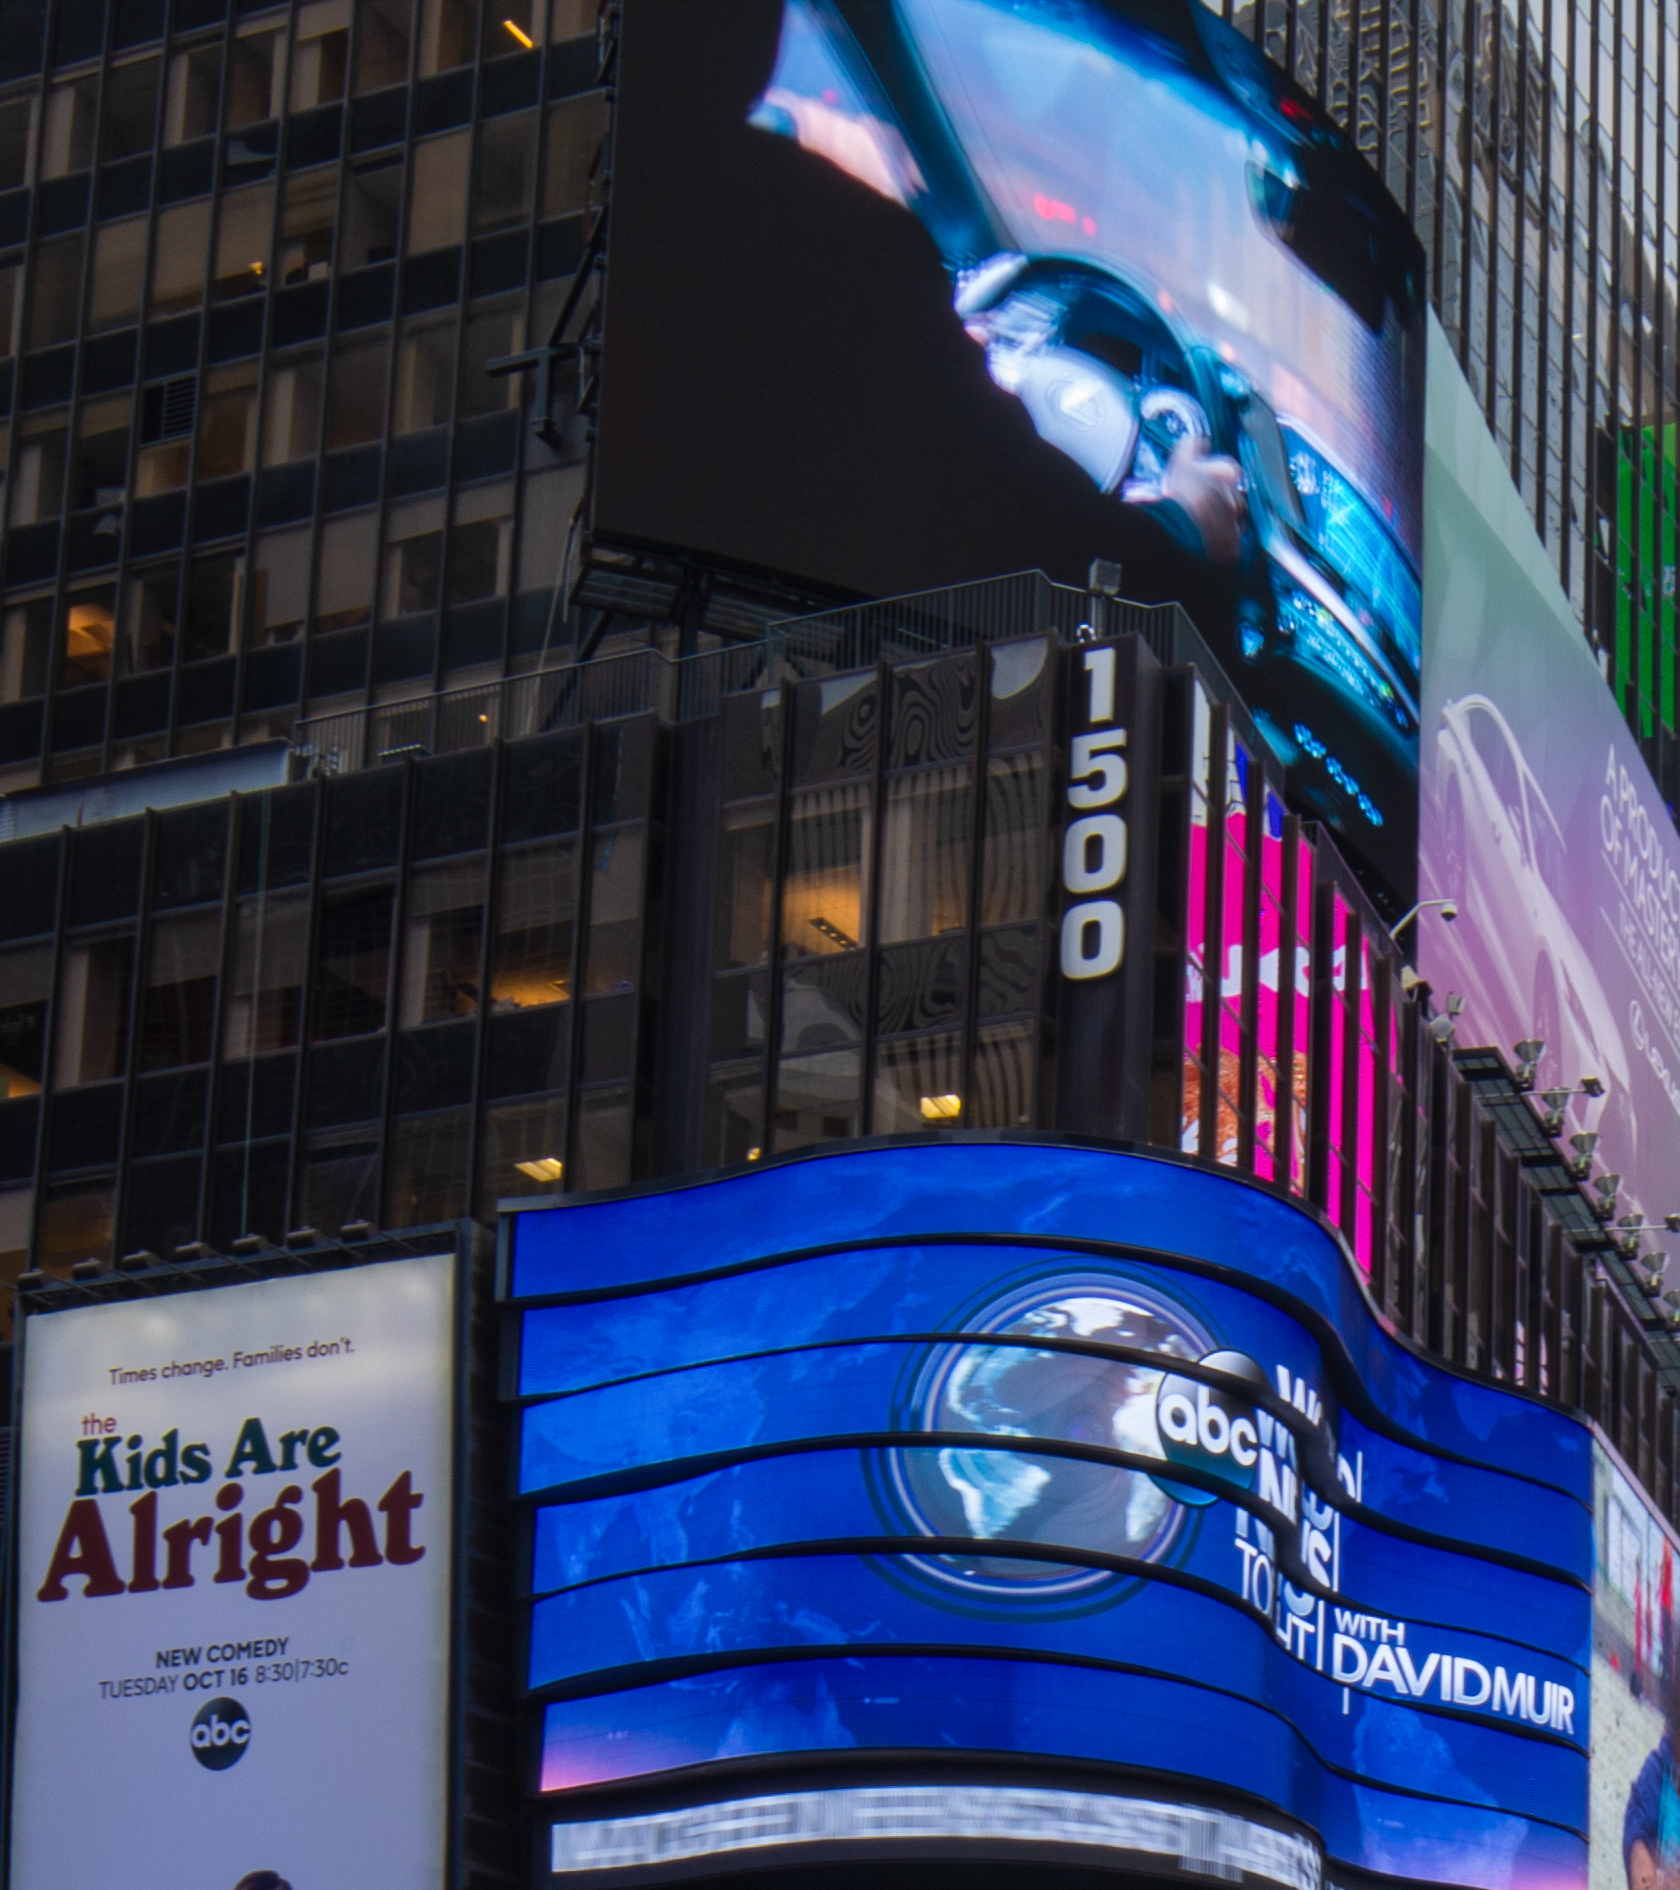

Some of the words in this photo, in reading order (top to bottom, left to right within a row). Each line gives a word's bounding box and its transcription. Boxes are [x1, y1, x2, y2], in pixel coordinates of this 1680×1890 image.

[1059, 646, 1128, 981] 1500
[109, 1365, 157, 1386] Times
[161, 1357, 229, 1381] change.
[232, 1341, 303, 1370] Families
[306, 1336, 355, 1360] don't.
[81, 1413, 117, 1436] the
[1157, 1385, 1258, 1467] abc
[75, 1428, 212, 1497] Kids
[224, 1417, 342, 1478] Are
[36, 1467, 426, 1603] Alright
[1333, 1607, 1405, 1646] WITH
[155, 1647, 202, 1670] NEW
[206, 1637, 290, 1664] COMEDY
[98, 1673, 179, 1700] TUESDAY
[182, 1669, 224, 1691] OCT
[229, 1666, 248, 1687] 16
[1332, 1632, 1491, 1707] DAVID
[1491, 1666, 1575, 1735] MUIR
[191, 1714, 251, 1749] abc
